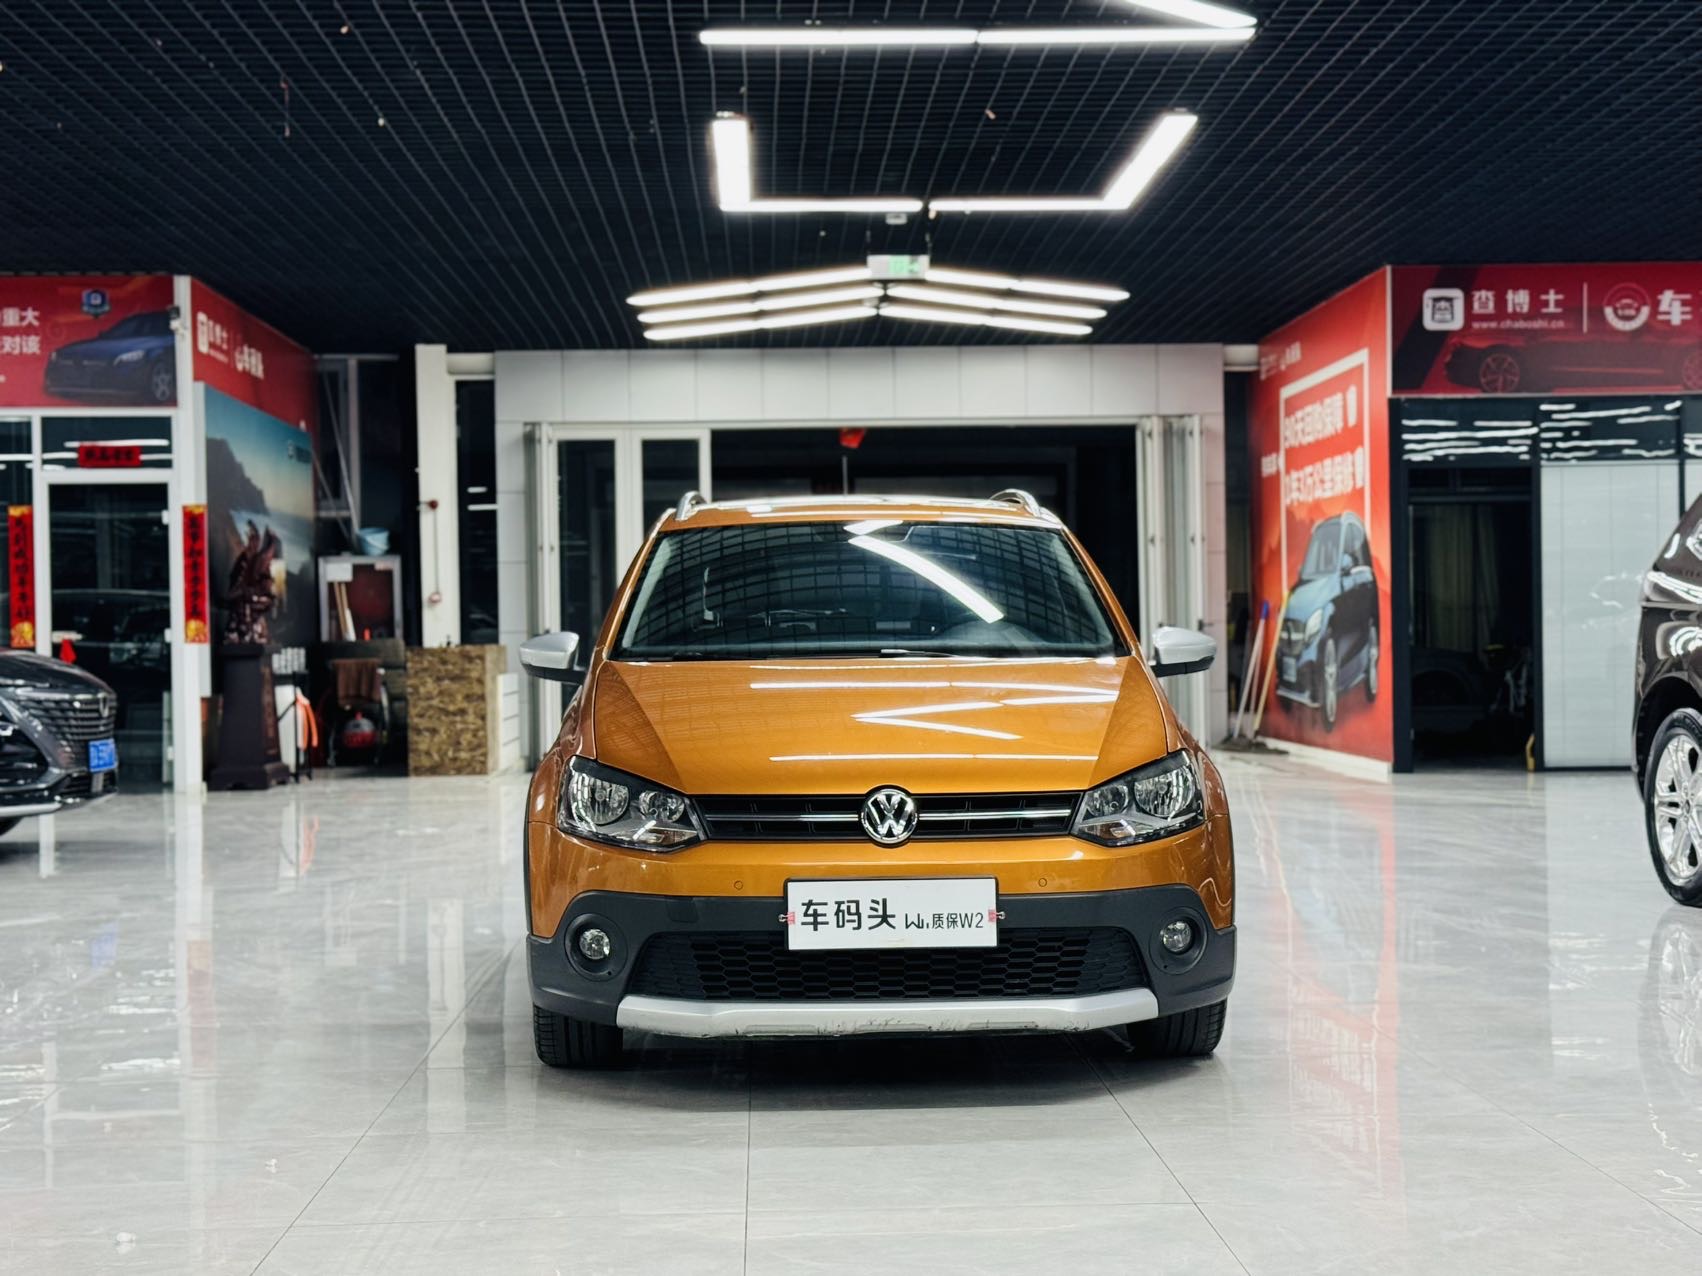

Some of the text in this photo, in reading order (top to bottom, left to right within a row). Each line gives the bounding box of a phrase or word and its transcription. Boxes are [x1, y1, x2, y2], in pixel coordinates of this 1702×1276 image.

[1470, 288, 1564, 314] 查博士
[1656, 288, 1702, 326] 车
[0, 307, 41, 328] 重大
[0, 335, 42, 356] 对该
[800, 897, 984, 932] 车码头 质保W2
